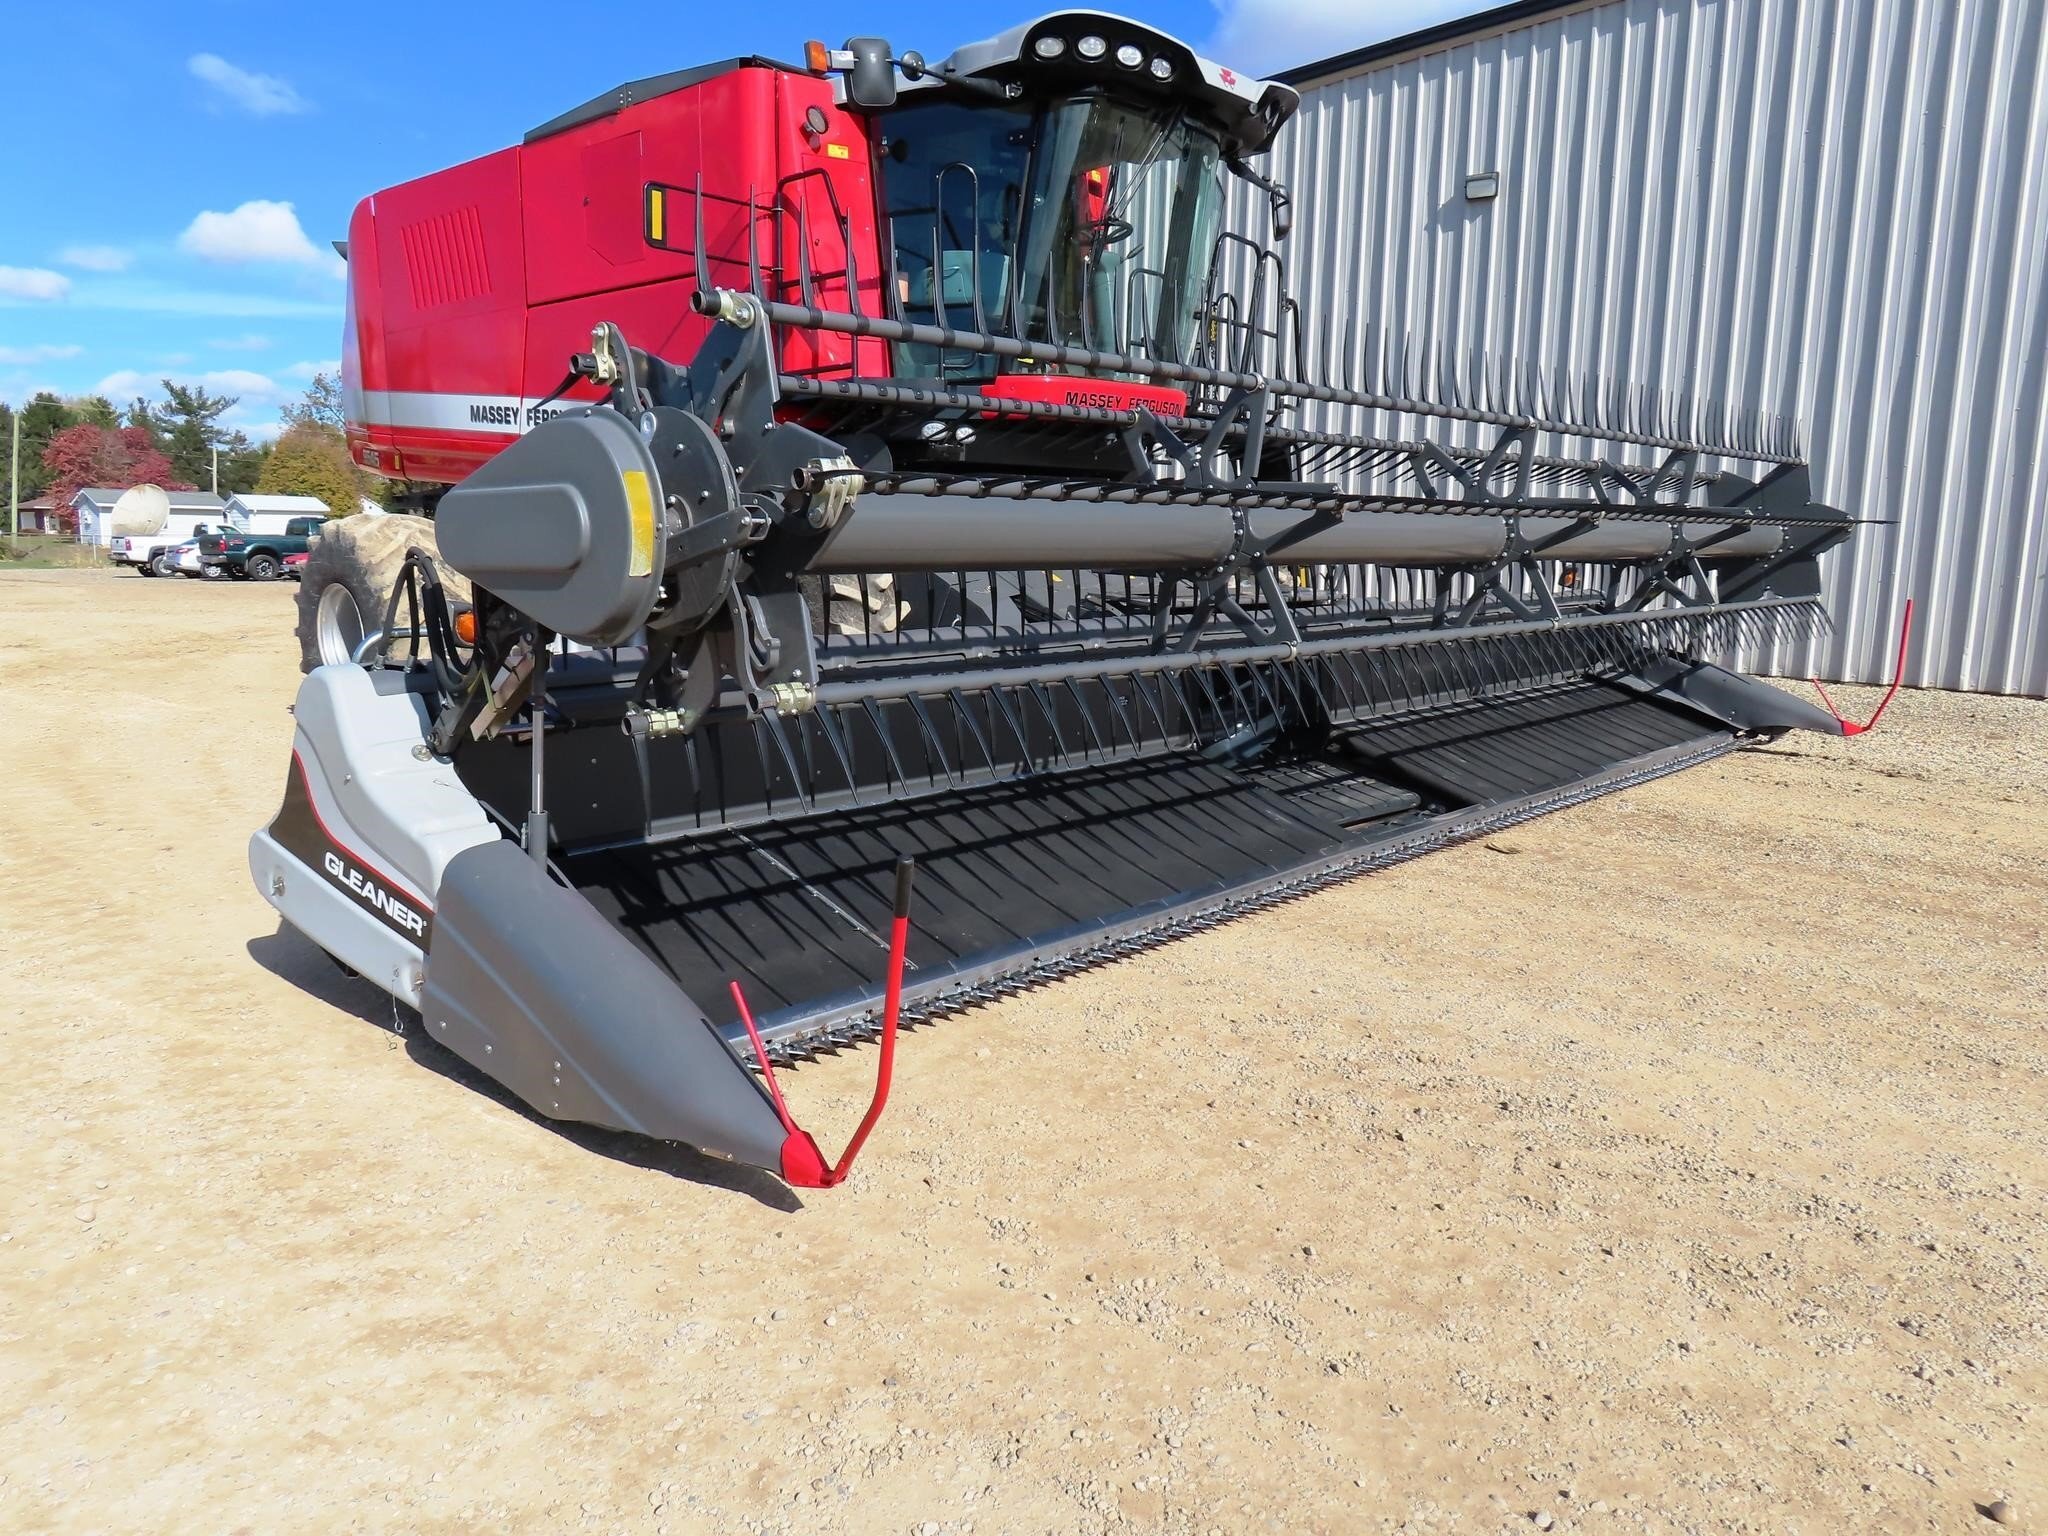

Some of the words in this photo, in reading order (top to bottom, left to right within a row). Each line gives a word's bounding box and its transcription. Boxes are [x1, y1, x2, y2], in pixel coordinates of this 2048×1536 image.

[1065, 391, 1122, 408] MASSEY
[470, 404, 520, 426] MASSEY
[324, 851, 423, 937] GLEANER
